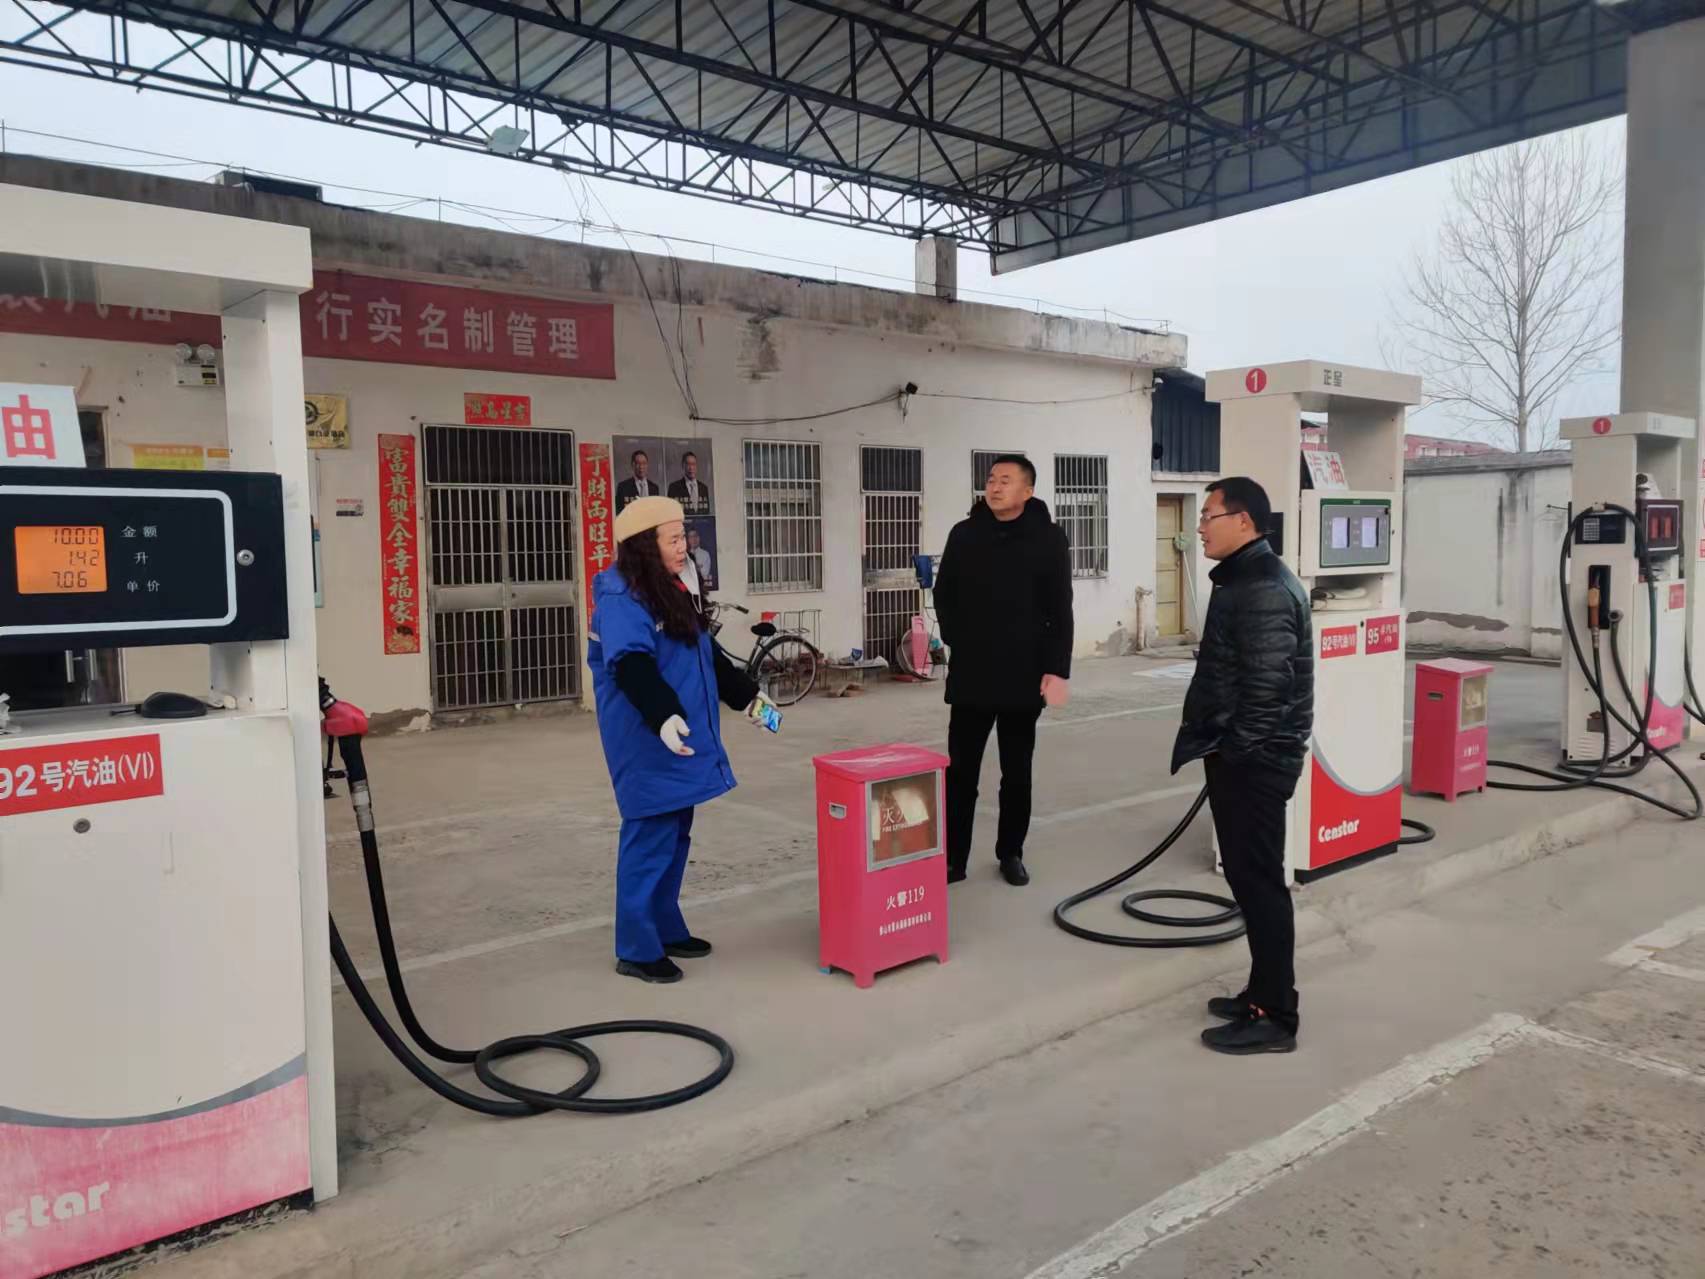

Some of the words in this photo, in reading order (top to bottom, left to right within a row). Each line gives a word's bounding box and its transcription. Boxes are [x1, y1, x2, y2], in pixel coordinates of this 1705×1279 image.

[315, 290, 579, 359] 行实名制管理
[120, 525, 158, 538] 金额
[134, 551, 148, 565] 升
[51, 571, 88, 589] 7.06
[126, 579, 161, 593] 单价
[1318, 819, 1360, 843] Censtar
[886, 885, 925, 911] 火警119
